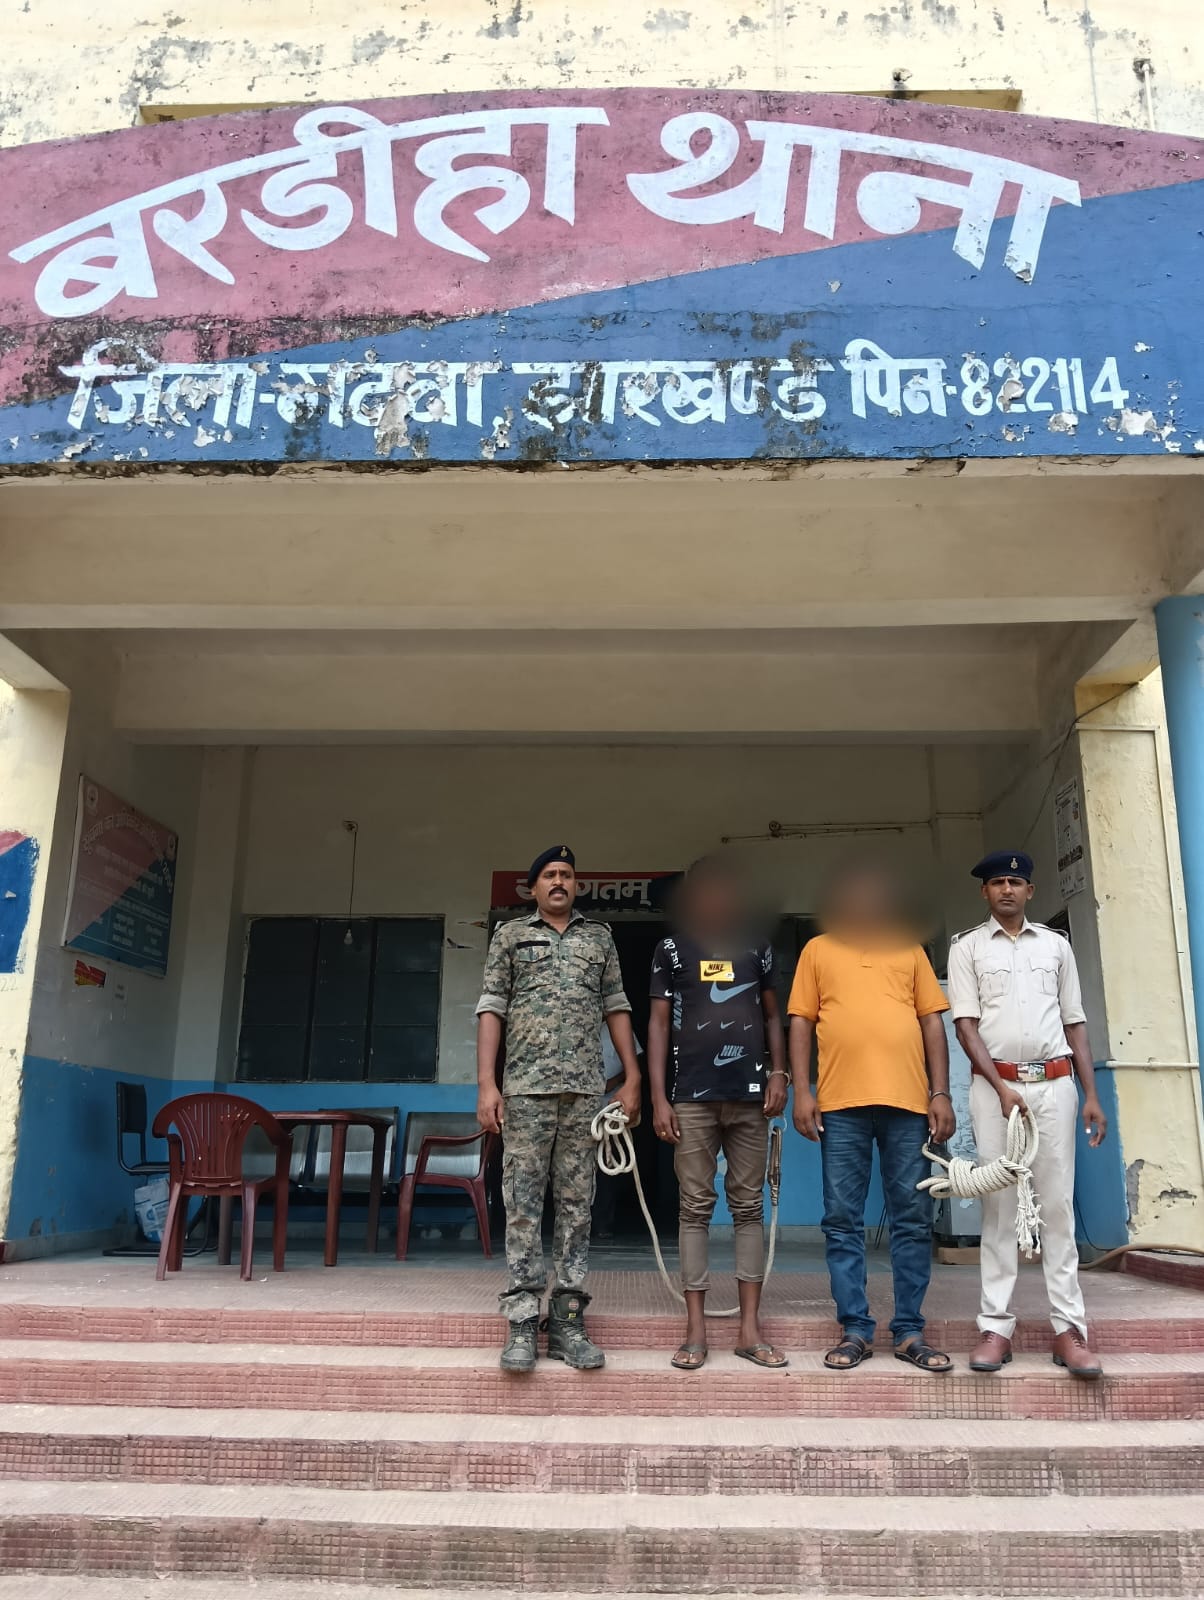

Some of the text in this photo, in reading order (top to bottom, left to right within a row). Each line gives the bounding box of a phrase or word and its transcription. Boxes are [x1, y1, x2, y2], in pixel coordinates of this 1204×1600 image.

[8, 106, 1082, 318] बरडीहा थाना
[720, 1045, 744, 1057] NIKE
